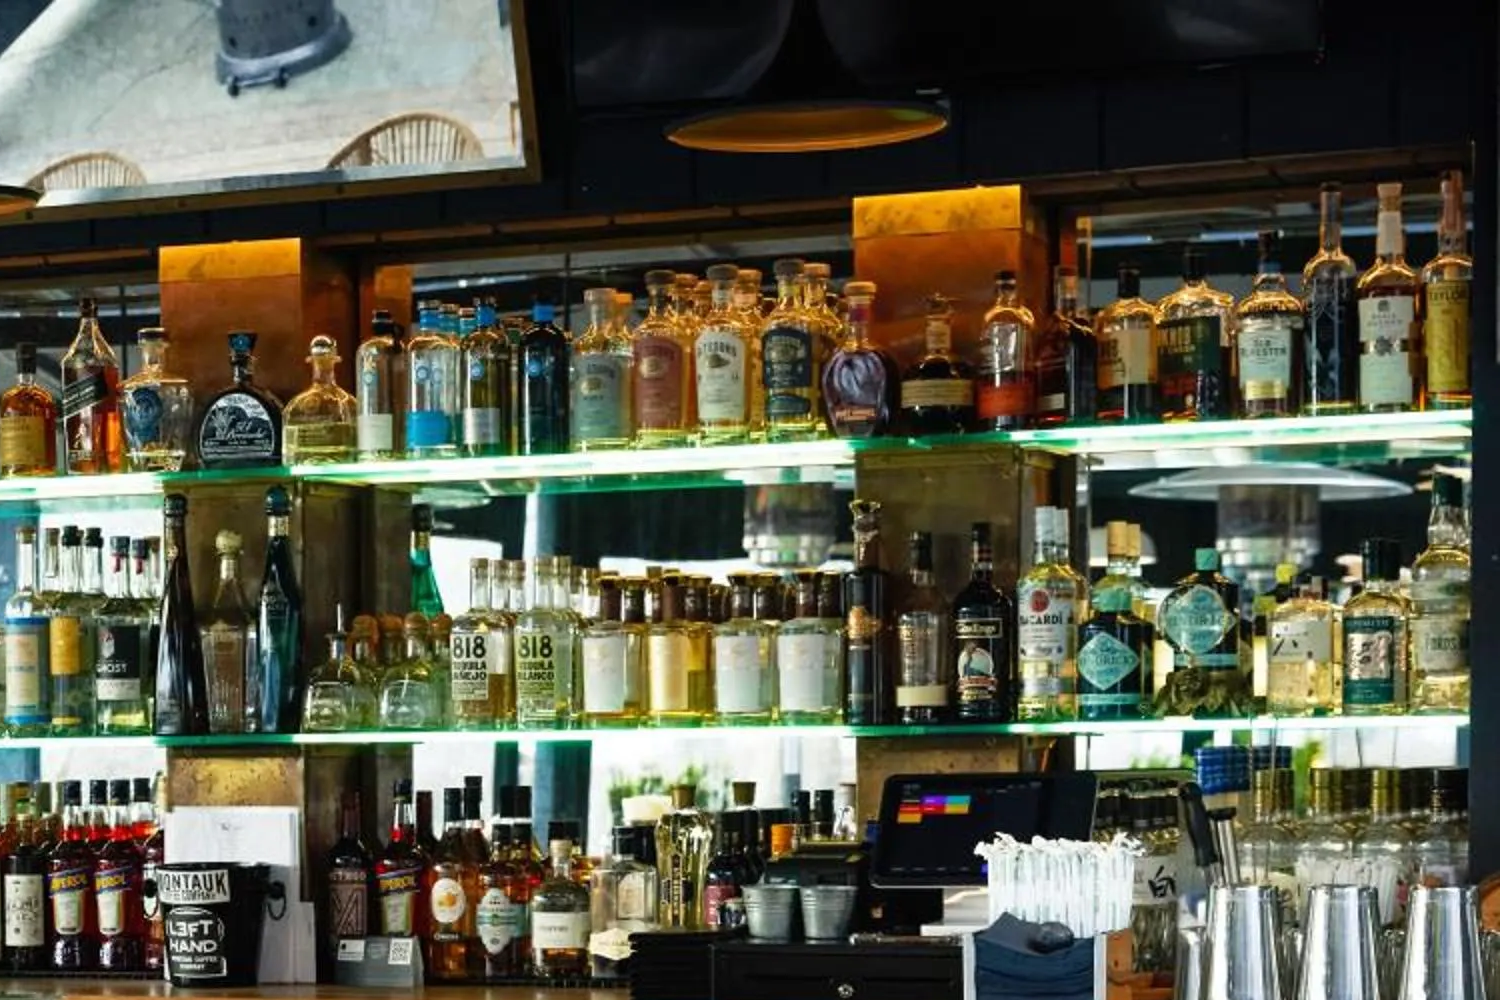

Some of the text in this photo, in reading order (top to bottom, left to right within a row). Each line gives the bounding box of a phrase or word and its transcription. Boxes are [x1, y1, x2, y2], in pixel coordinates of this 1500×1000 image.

[453, 635, 486, 659] 818
[518, 635, 553, 659] 818
[157, 872, 227, 897] MONTAUK
[1148, 865, 1177, 898] 白
[169, 938, 217, 953] HAND
